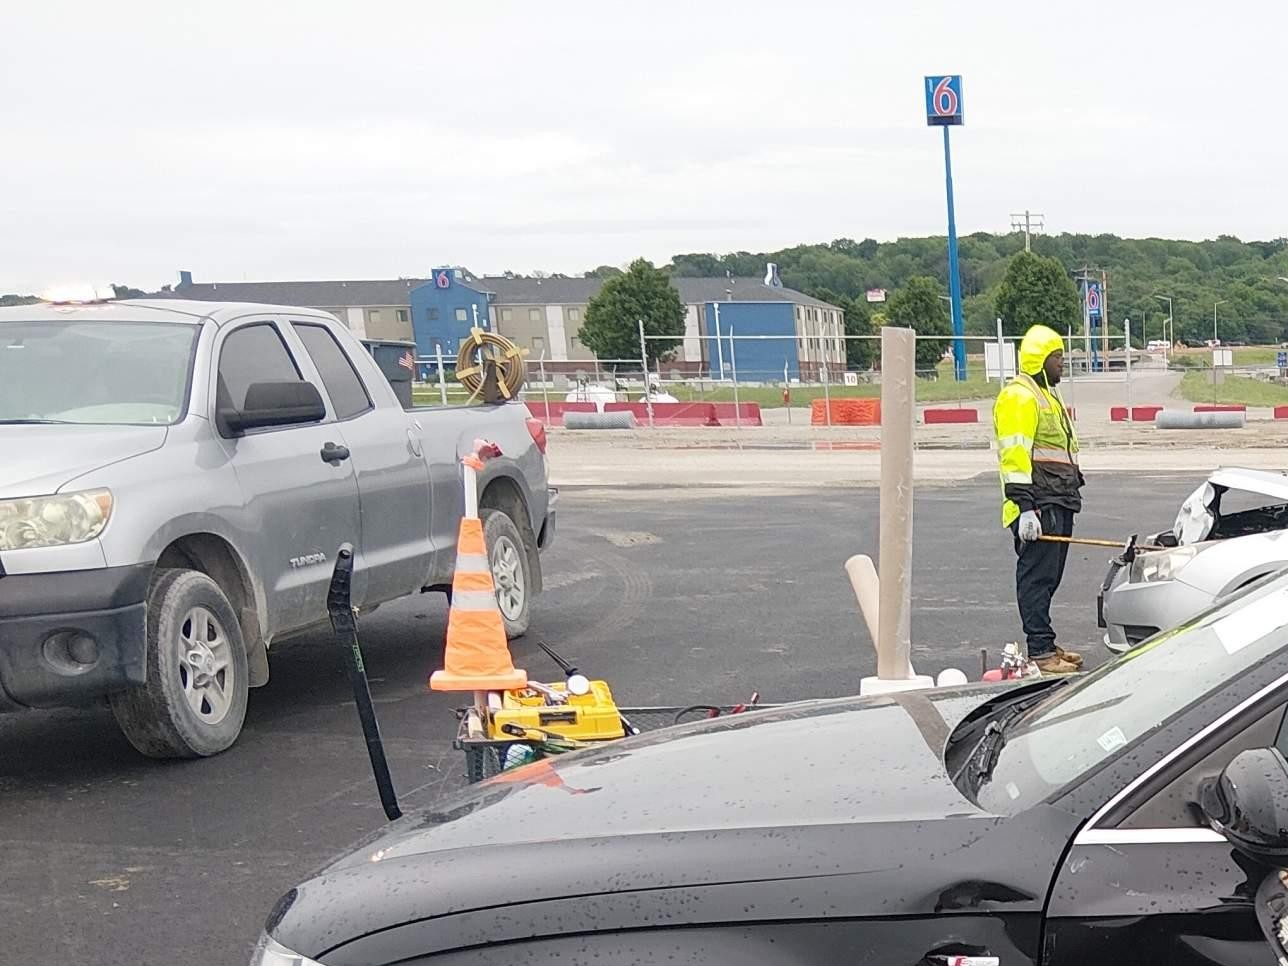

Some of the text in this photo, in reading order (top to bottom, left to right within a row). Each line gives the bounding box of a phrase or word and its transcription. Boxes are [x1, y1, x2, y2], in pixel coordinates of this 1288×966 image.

[933, 76, 957, 116] 6
[437, 271, 449, 289] 6
[1087, 284, 1099, 310] 6
[846, 375, 856, 384] 10
[289, 552, 327, 568] TUNDRA
